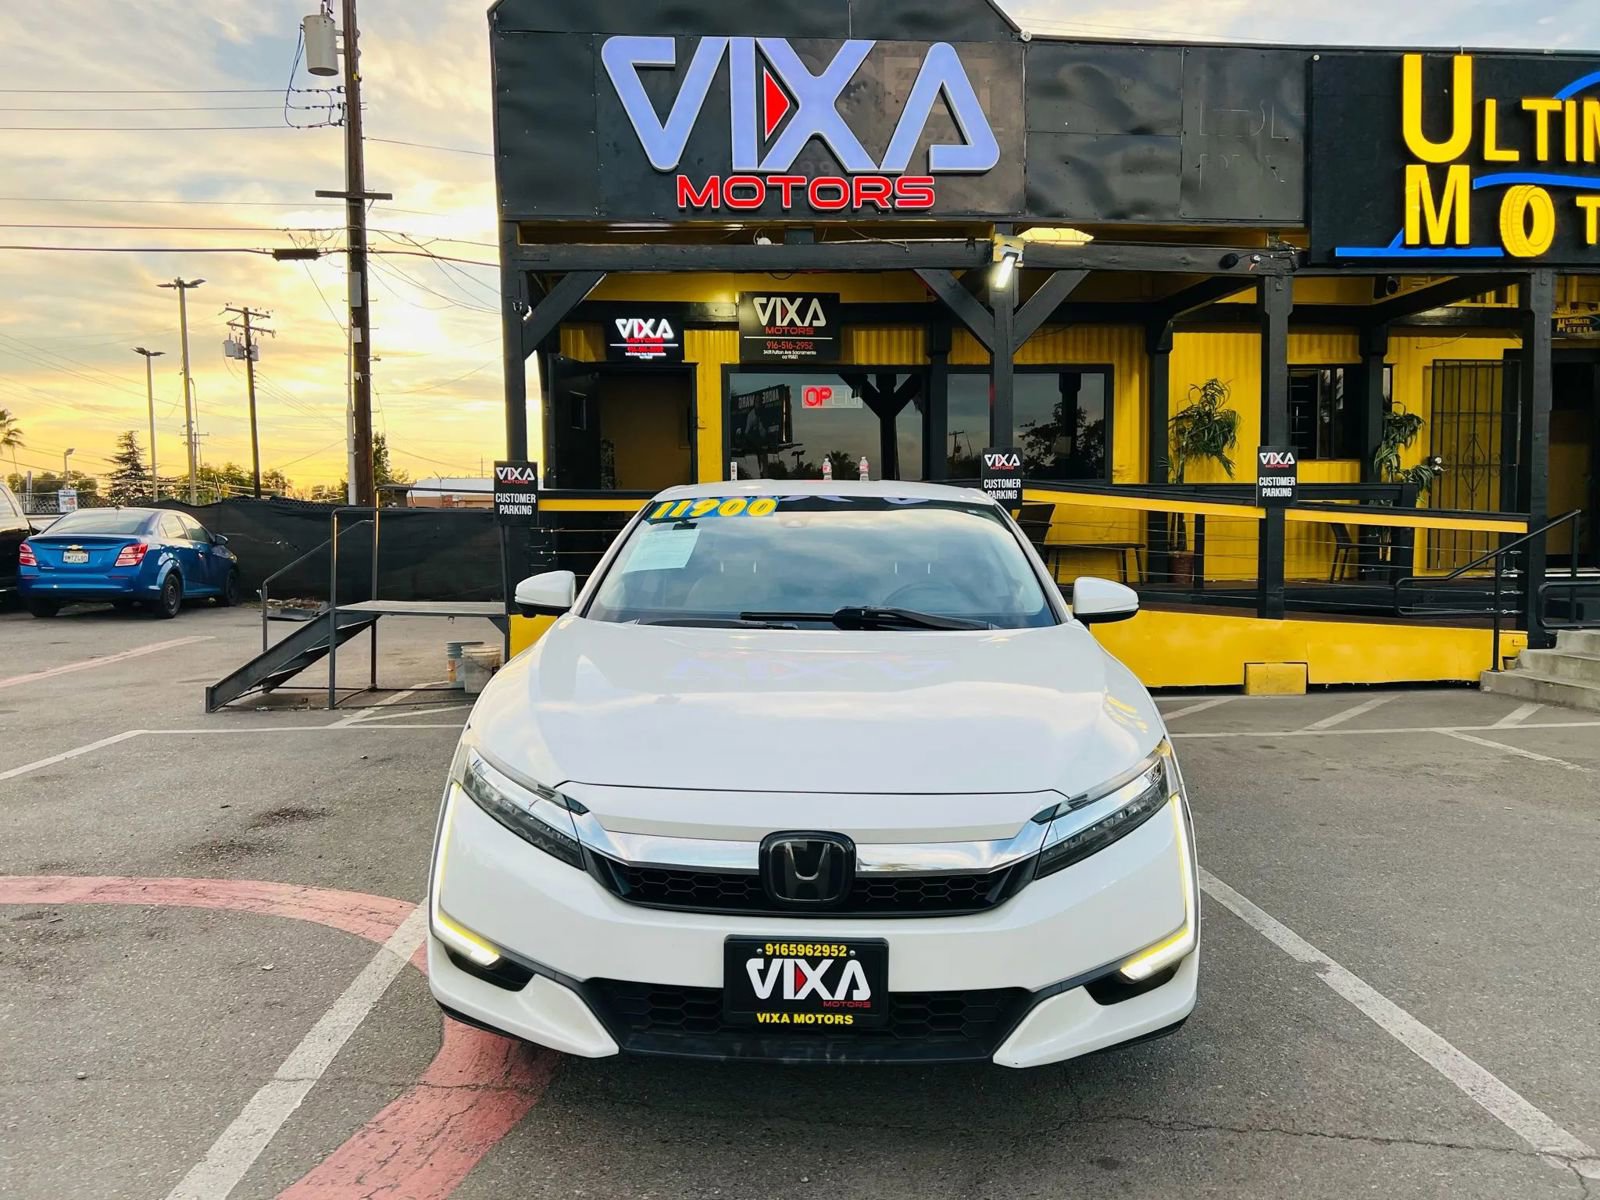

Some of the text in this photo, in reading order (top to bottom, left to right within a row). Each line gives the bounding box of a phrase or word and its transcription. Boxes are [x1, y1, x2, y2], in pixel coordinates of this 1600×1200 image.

[601, 36, 1000, 174] VIXA
[677, 175, 936, 211] MOTORS
[752, 297, 827, 327] VIXA
[615, 318, 675, 339] VIXA
[765, 326, 815, 335] MOTORS
[984, 453, 1021, 467] VIXA
[1259, 452, 1296, 465] VIXA
[496, 466, 536, 481] VIXA
[983, 479, 1021, 489] CUSTOMER
[1259, 476, 1296, 486] CUSTOMER
[495, 492, 537, 503] CUSTOMER
[1262, 487, 1292, 497] PARKING
[499, 504, 533, 515] PARKING
[650, 497, 779, 519] 11900
[765, 943, 848, 957] 9165962952
[745, 958, 871, 1001] VIXA
[823, 1001, 871, 1009] MOTORS
[756, 1012, 854, 1025] VIXA MOTORS
